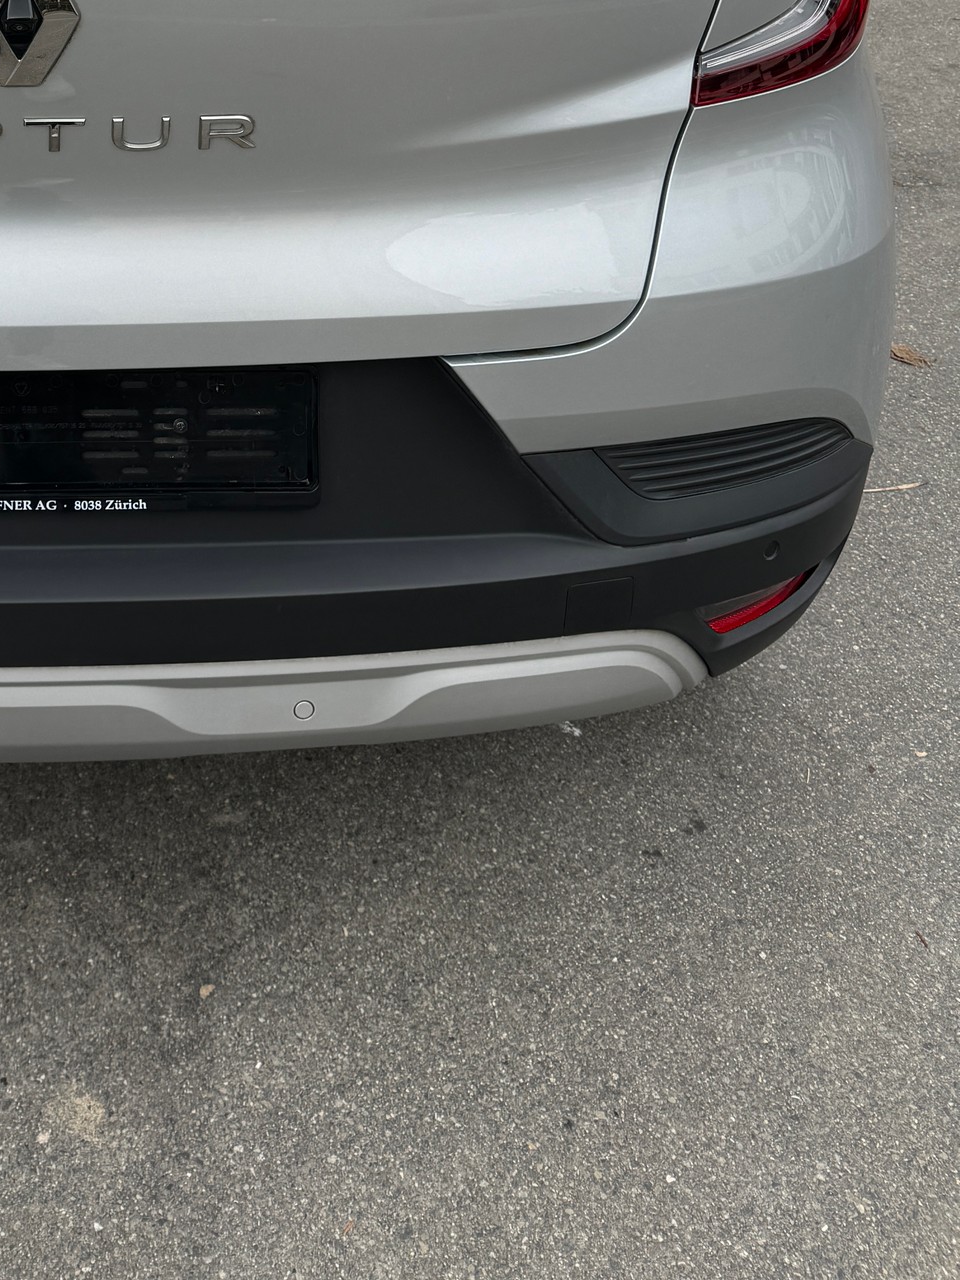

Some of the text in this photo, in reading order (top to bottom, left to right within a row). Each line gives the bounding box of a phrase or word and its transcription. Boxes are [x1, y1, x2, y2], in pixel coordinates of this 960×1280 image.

[35, 500, 57, 511] AG
[74, 500, 102, 511] 8038
[105, 498, 147, 510] Zürich
